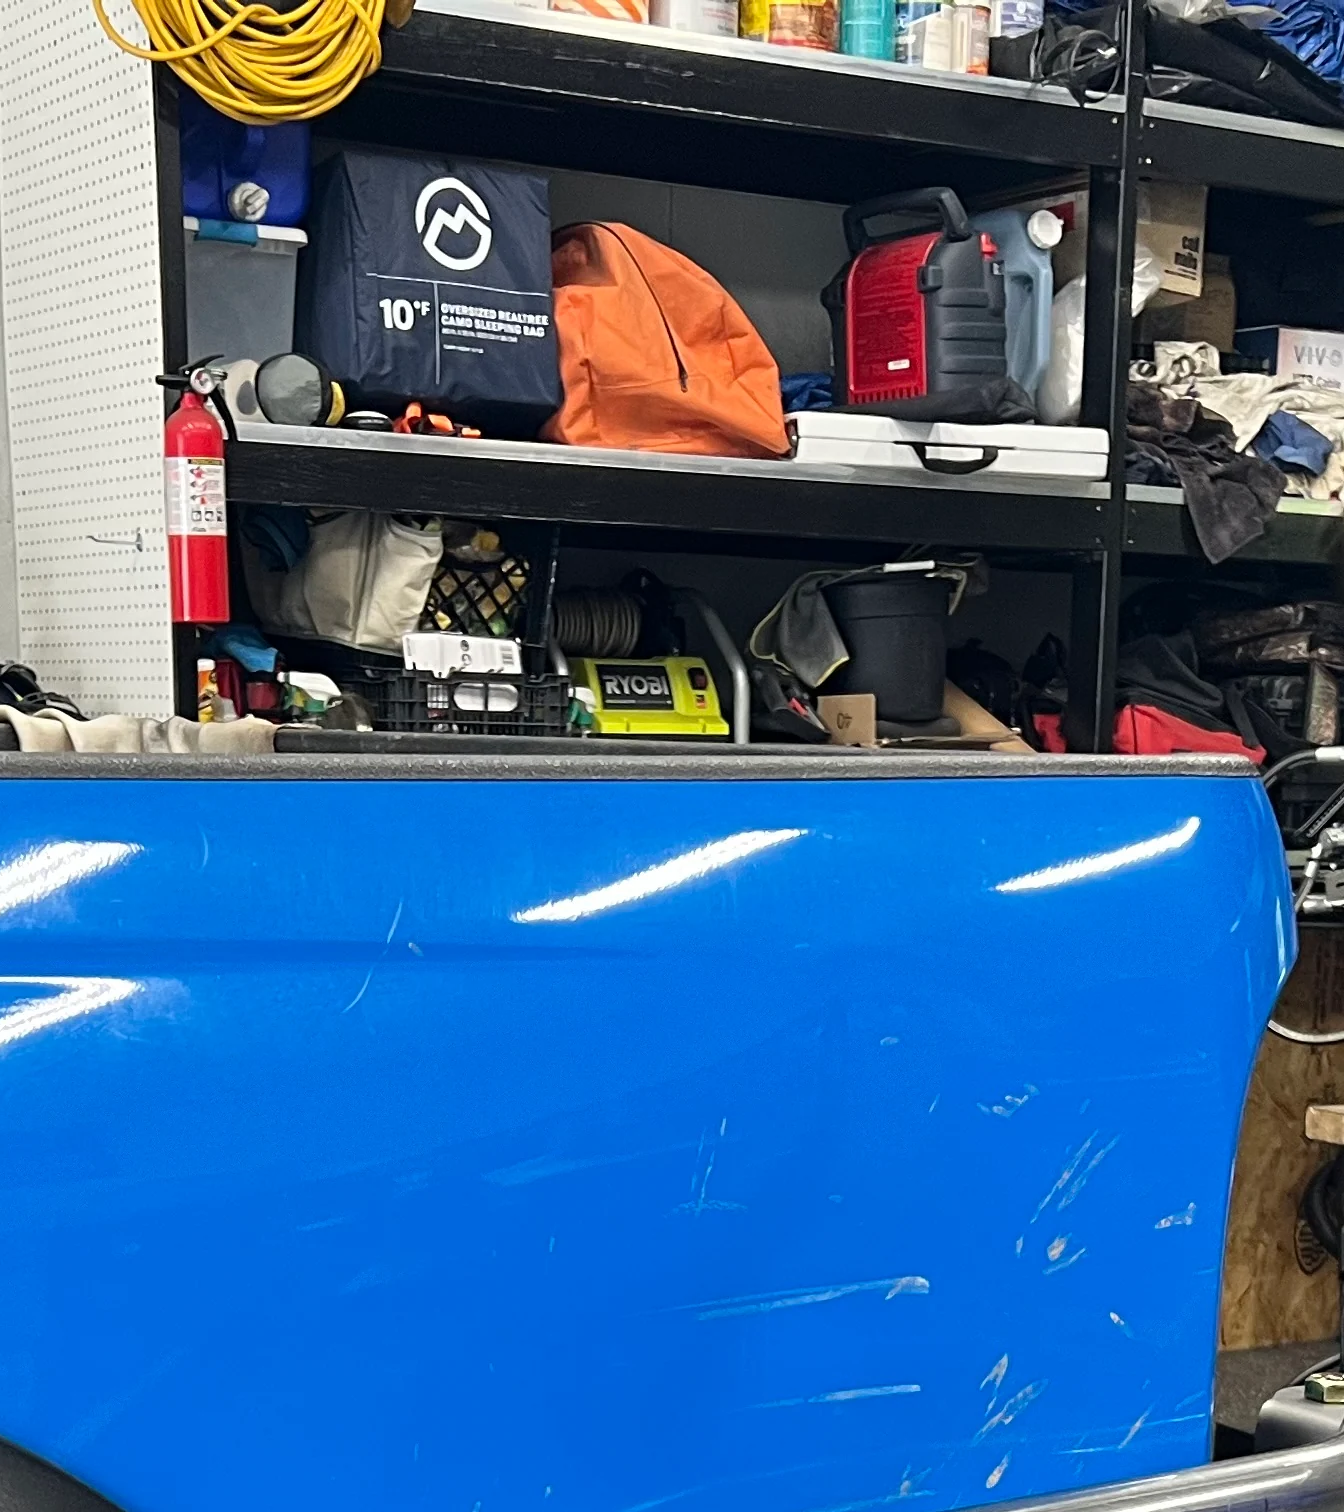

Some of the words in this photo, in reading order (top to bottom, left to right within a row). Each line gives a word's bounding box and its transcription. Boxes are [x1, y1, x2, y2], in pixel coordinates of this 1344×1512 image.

[440, 315, 474, 329] CAMO
[473, 318, 522, 335] SLEEPING
[601, 674, 670, 696] RYOBI
